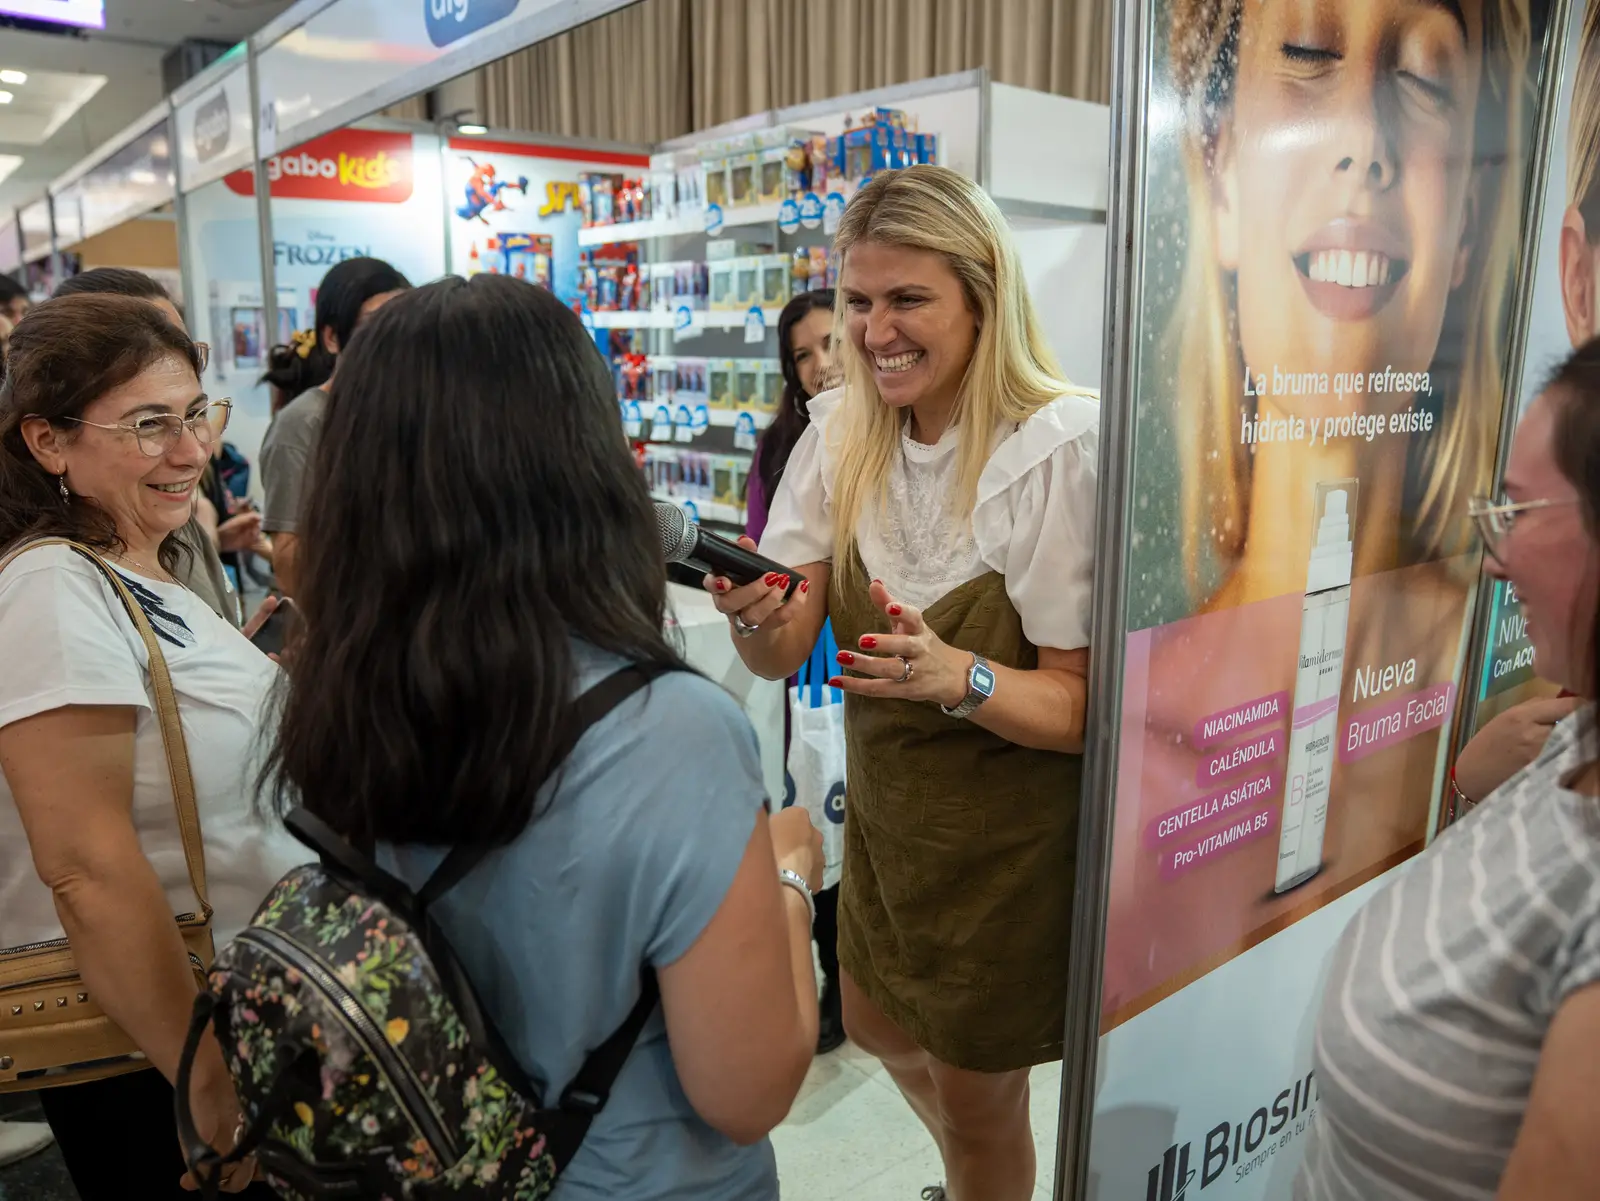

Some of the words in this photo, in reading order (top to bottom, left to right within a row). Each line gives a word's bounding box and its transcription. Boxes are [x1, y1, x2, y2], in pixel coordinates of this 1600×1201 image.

[272, 241, 371, 266] FROZEN
[1244, 366, 1267, 396] La
[1272, 364, 1329, 396] bruma
[1333, 371, 1364, 400] que
[1367, 365, 1433, 396] refresca,
[1240, 411, 1305, 444] hidrata
[1309, 416, 1320, 447] y
[1323, 412, 1386, 445] protege
[1389, 406, 1434, 433] existe
[1352, 658, 1416, 703] Nueva
[1493, 658, 1513, 679] Con
[1203, 698, 1279, 740] NIACINAMIDA
[1347, 711, 1401, 752] Bruma
[1404, 686, 1451, 729] Facial
[1209, 737, 1275, 776] CALÉNDULA
[1158, 798, 1219, 838] CENTELLA
[1221, 775, 1271, 811] ASIÁTICA
[1173, 821, 1252, 870] Pro-VITAMINA
[1253, 811, 1269, 832] B5
[1234, 1142, 1277, 1184] Siempre
[1279, 1130, 1293, 1149] en
[1294, 1119, 1306, 1136] tu
